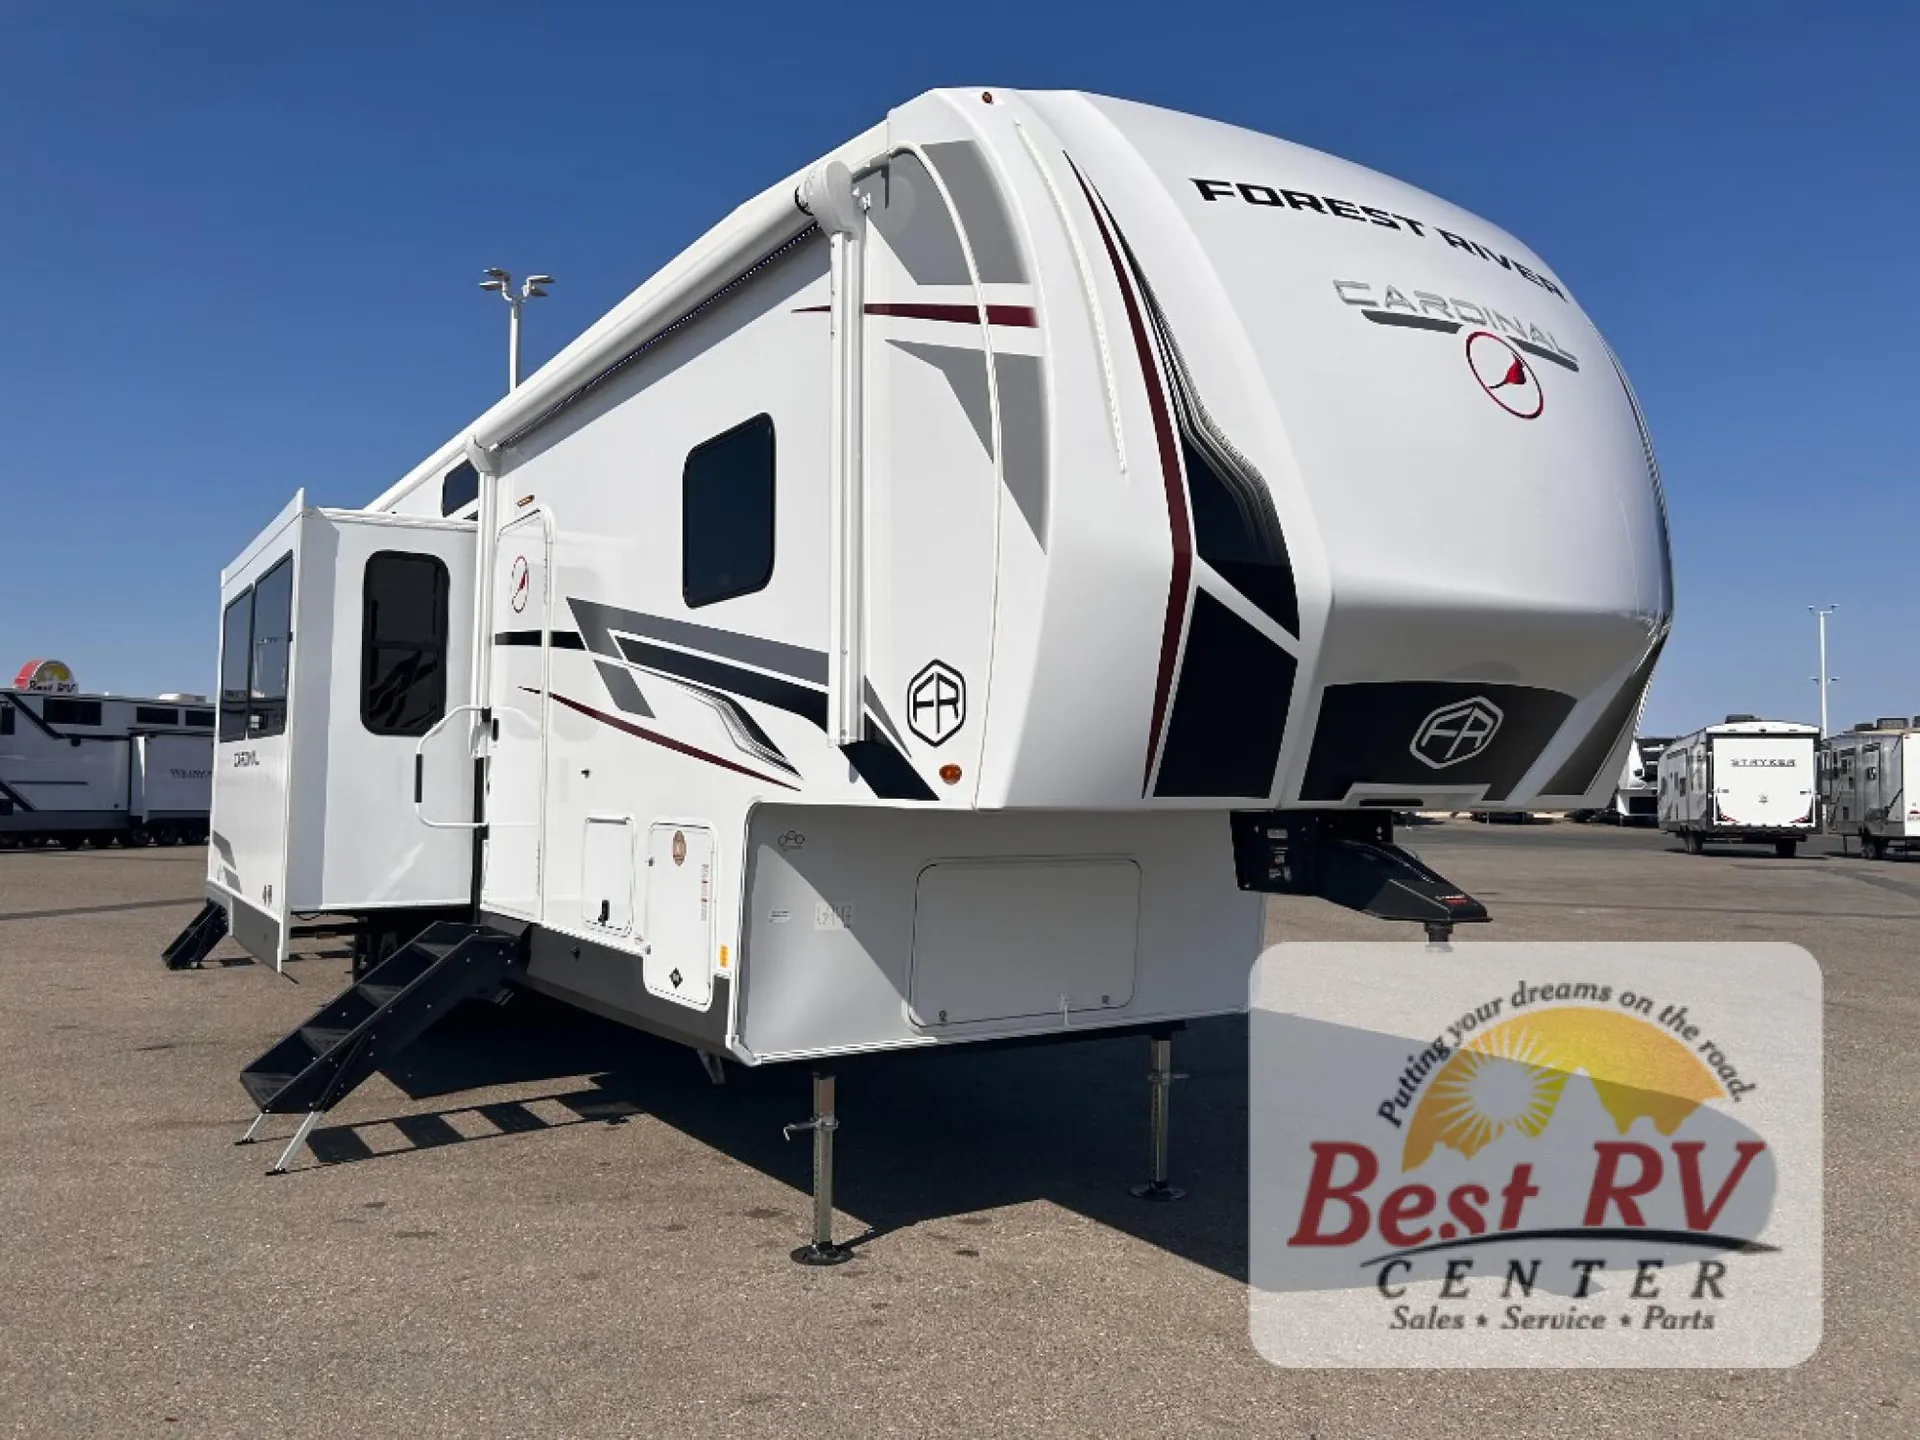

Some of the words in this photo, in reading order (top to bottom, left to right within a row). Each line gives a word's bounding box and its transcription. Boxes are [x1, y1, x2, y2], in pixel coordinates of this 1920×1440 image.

[1190, 177, 1426, 237] FOREST
[1434, 226, 1569, 302] RIVER
[1333, 279, 1580, 361] CARDINAL
[1730, 758, 1797, 768] STRYKER
